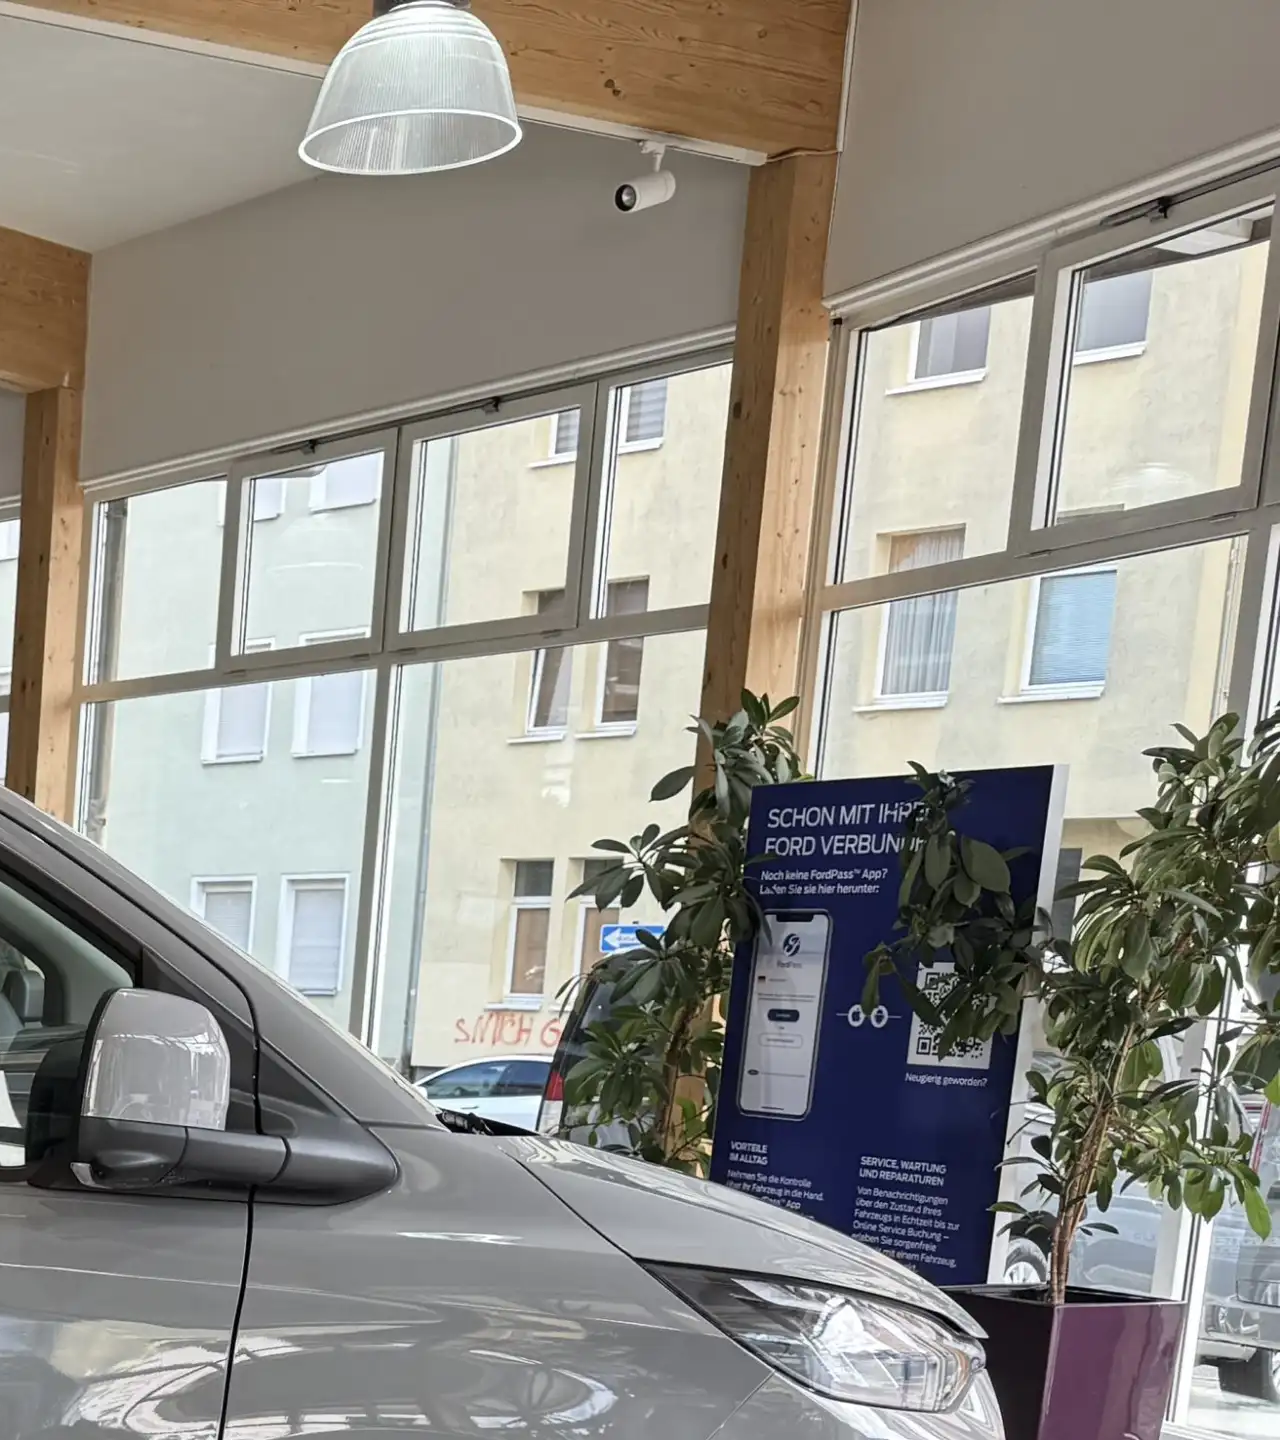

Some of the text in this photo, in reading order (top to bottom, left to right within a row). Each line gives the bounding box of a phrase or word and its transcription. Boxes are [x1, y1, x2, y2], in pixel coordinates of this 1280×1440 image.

[768, 805, 836, 828] SCHON
[839, 803, 876, 825] MIT
[765, 835, 816, 857] FORD
[761, 869, 784, 881] Noch
[785, 869, 809, 880] keine
[861, 867, 888, 881] App?
[788, 883, 802, 895] Sie
[803, 884, 817, 894] sie
[817, 883, 836, 894] hier
[836, 882, 880, 894] herunter:
[905, 1072, 988, 1087] Neugierig geworden?
[730, 1141, 768, 1154] VORTEILE
[900, 1159, 947, 1174] WARTUNG
[859, 1168, 944, 1186] UND REPARATUREN
[857, 1185, 948, 1206] Von Benachrichtigungen
[874, 1199, 889, 1210] den
[890, 1201, 921, 1214] Zustand
[853, 1208, 892, 1222] Fahrzeugs
[901, 1214, 933, 1228] Echtzeit
[933, 1218, 946, 1229] bis
[946, 1221, 960, 1231] zur
[852, 1219, 877, 1232] Online
[878, 1223, 906, 1236] Service
[907, 1226, 942, 1242] Buchung
[880, 1235, 893, 1246] Sie
[893, 1238, 938, 1252] sorgenfreie
